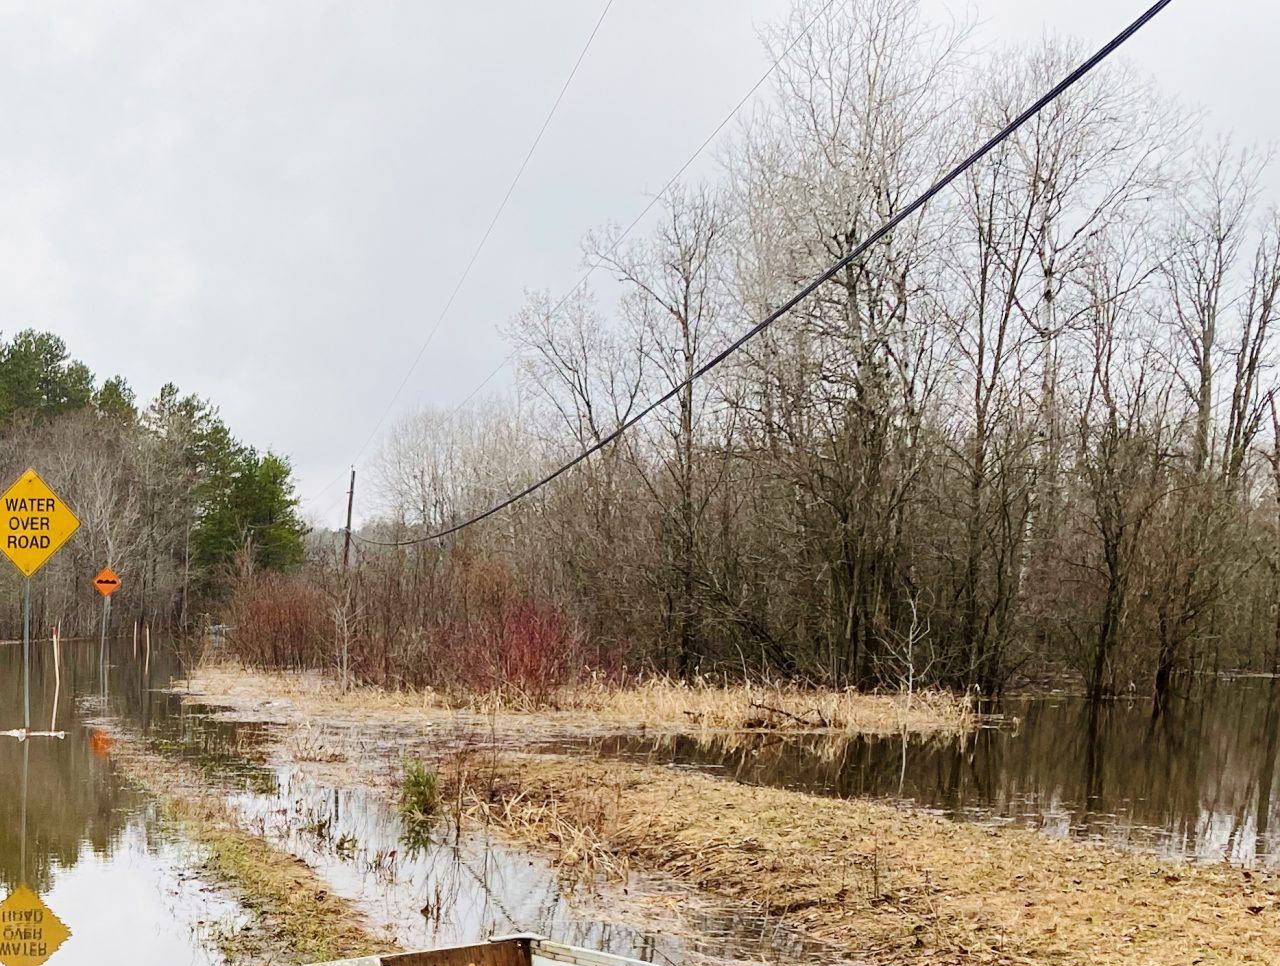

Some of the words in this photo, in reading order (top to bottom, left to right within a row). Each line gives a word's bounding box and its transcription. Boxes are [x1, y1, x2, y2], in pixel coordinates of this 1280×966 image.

[5, 498, 55, 512] WATER
[9, 517, 50, 531] OVER
[7, 535, 51, 549] ROAD
